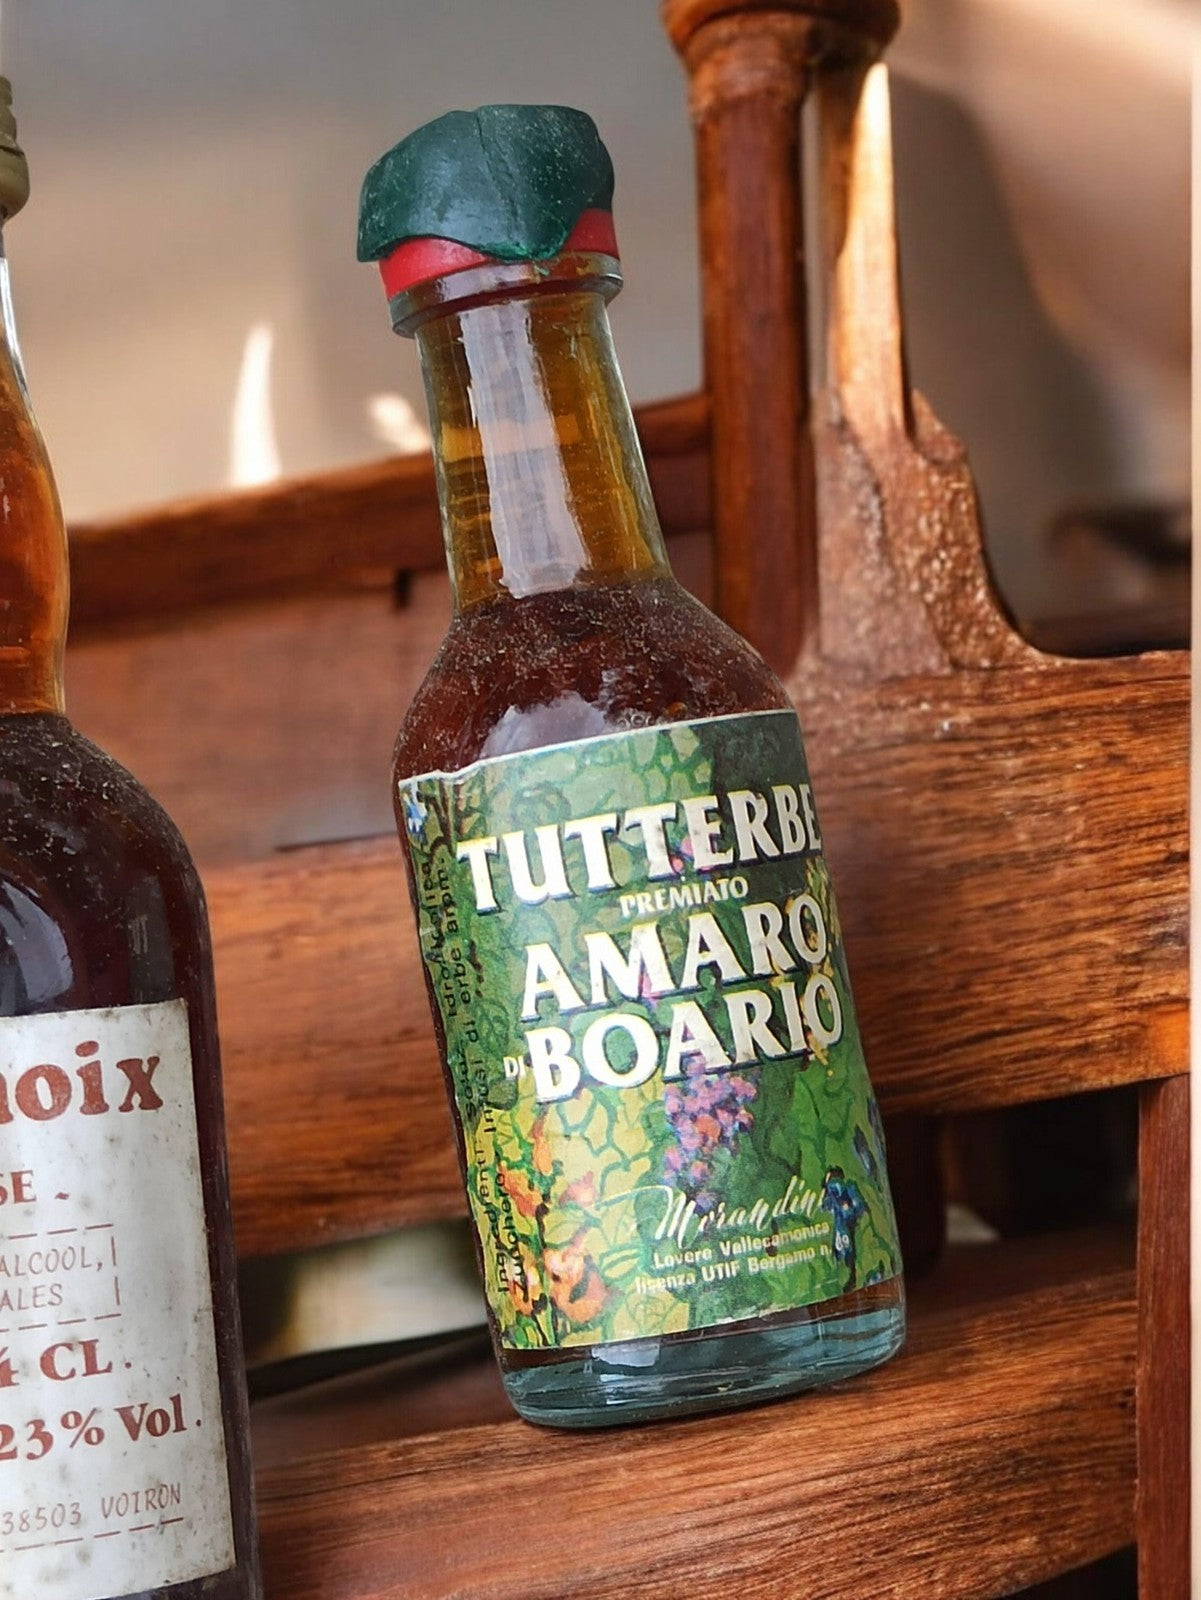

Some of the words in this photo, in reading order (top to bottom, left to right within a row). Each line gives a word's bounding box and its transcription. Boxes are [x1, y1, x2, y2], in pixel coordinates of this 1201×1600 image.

[456, 782, 822, 914] TUTTERBE
[620, 875, 750, 917] PREMIATO
[450, 947, 472, 1005] erbe
[520, 892, 828, 1022] AMARO
[463, 1020, 479, 1043] di
[503, 1054, 526, 1080] DI
[525, 973, 845, 1103] BOARIO
[0, 1040, 163, 1124] oix
[701, 1261, 742, 1284] UTIF
[748, 1246, 816, 1276] Bergamo
[114, 1393, 202, 1442] Vol.
[2, 1502, 82, 1535] 38503
[101, 1483, 181, 1519] VOIRON
